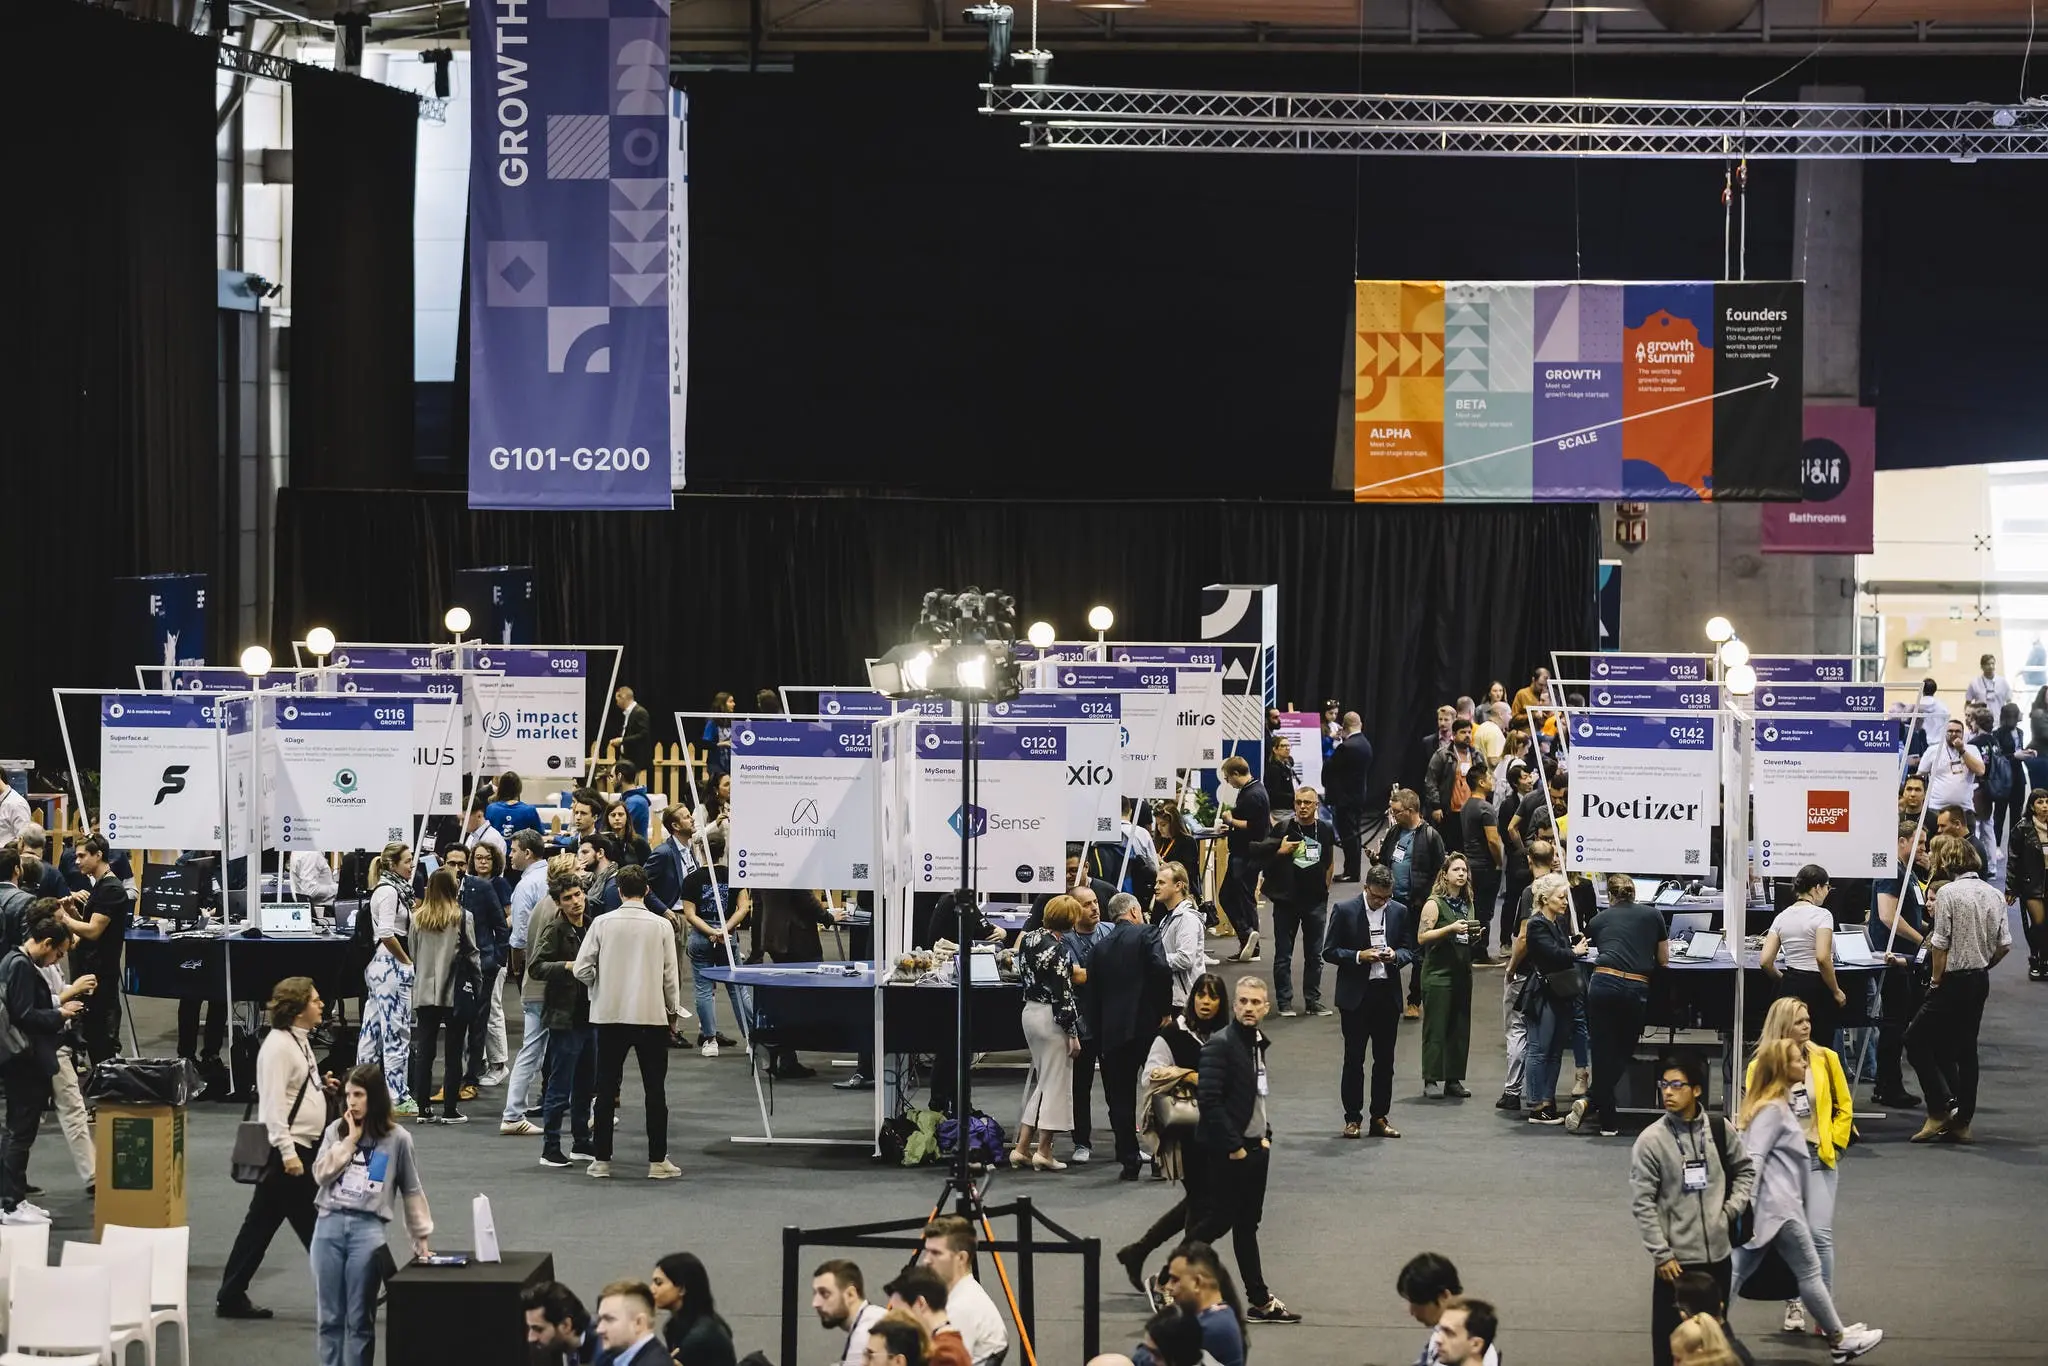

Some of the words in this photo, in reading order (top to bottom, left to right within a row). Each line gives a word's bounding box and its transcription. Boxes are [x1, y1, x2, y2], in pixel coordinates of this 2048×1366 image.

[496, 0, 528, 187] GROWTH
[1647, 338, 1694, 354] growth
[1648, 351, 1695, 363] summit
[1546, 370, 1601, 380] GROWTH
[1545, 391, 1584, 399] growth-stage
[1585, 391, 1609, 399] startups
[1456, 399, 1487, 410] BETA
[1370, 428, 1412, 439] ALPHA
[1558, 431, 1598, 450] SCALE
[490, 447, 650, 471] G101-G200
[1789, 512, 1847, 523] Bathrooms
[551, 659, 579, 669] G109
[1191, 655, 1215, 664] G131
[1670, 665, 1698, 676] G134
[1816, 667, 1844, 676] G133
[1141, 675, 1169, 684] G128
[1680, 694, 1711, 704] G138
[1846, 696, 1876, 706] G137
[153, 709, 171, 717] learning
[374, 708, 405, 720] G116
[913, 703, 944, 714] G125
[1081, 703, 1113, 714] G124
[517, 709, 578, 727] impact
[110, 734, 149, 742] Superface.ai
[517, 726, 578, 739] market
[1670, 727, 1705, 739] G142
[1858, 730, 1890, 742] G141
[839, 734, 872, 746] G121
[1021, 737, 1057, 749] G120
[740, 764, 780, 772] Algorithmiq
[1582, 793, 1698, 821] Poetizer
[774, 826, 837, 839] algorithmiq
